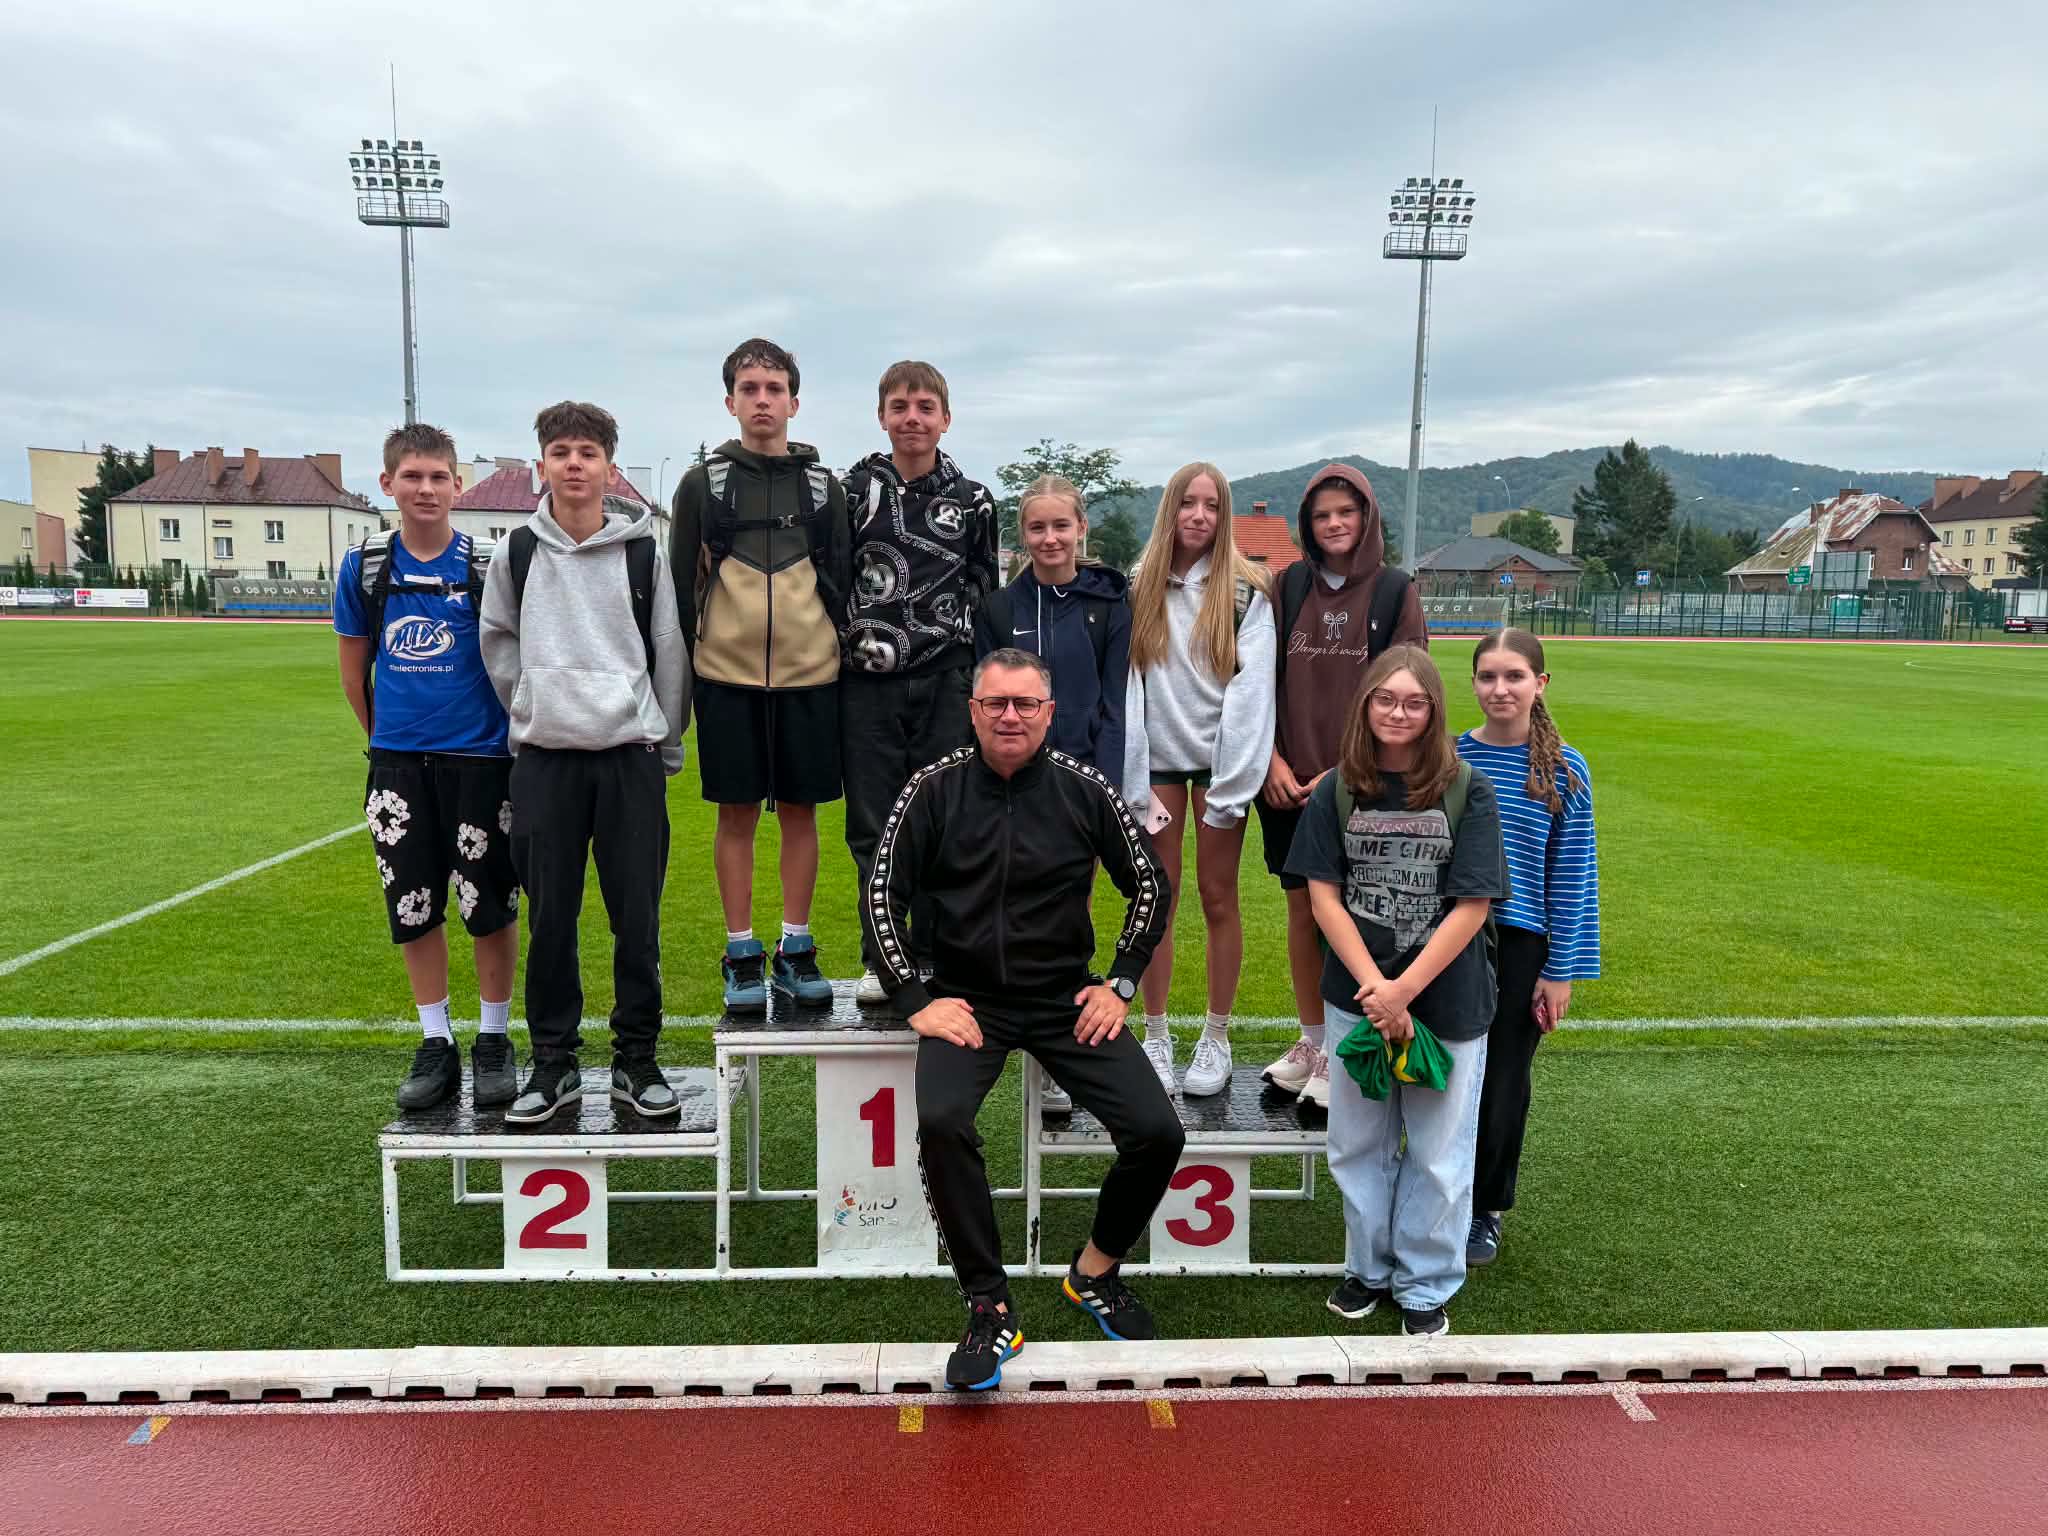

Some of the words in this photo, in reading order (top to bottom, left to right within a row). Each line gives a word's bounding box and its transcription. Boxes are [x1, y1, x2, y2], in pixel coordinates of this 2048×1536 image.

[859, 1087, 896, 1168] 1
[519, 1168, 590, 1249] 2
[1165, 1164, 1235, 1247] 3
